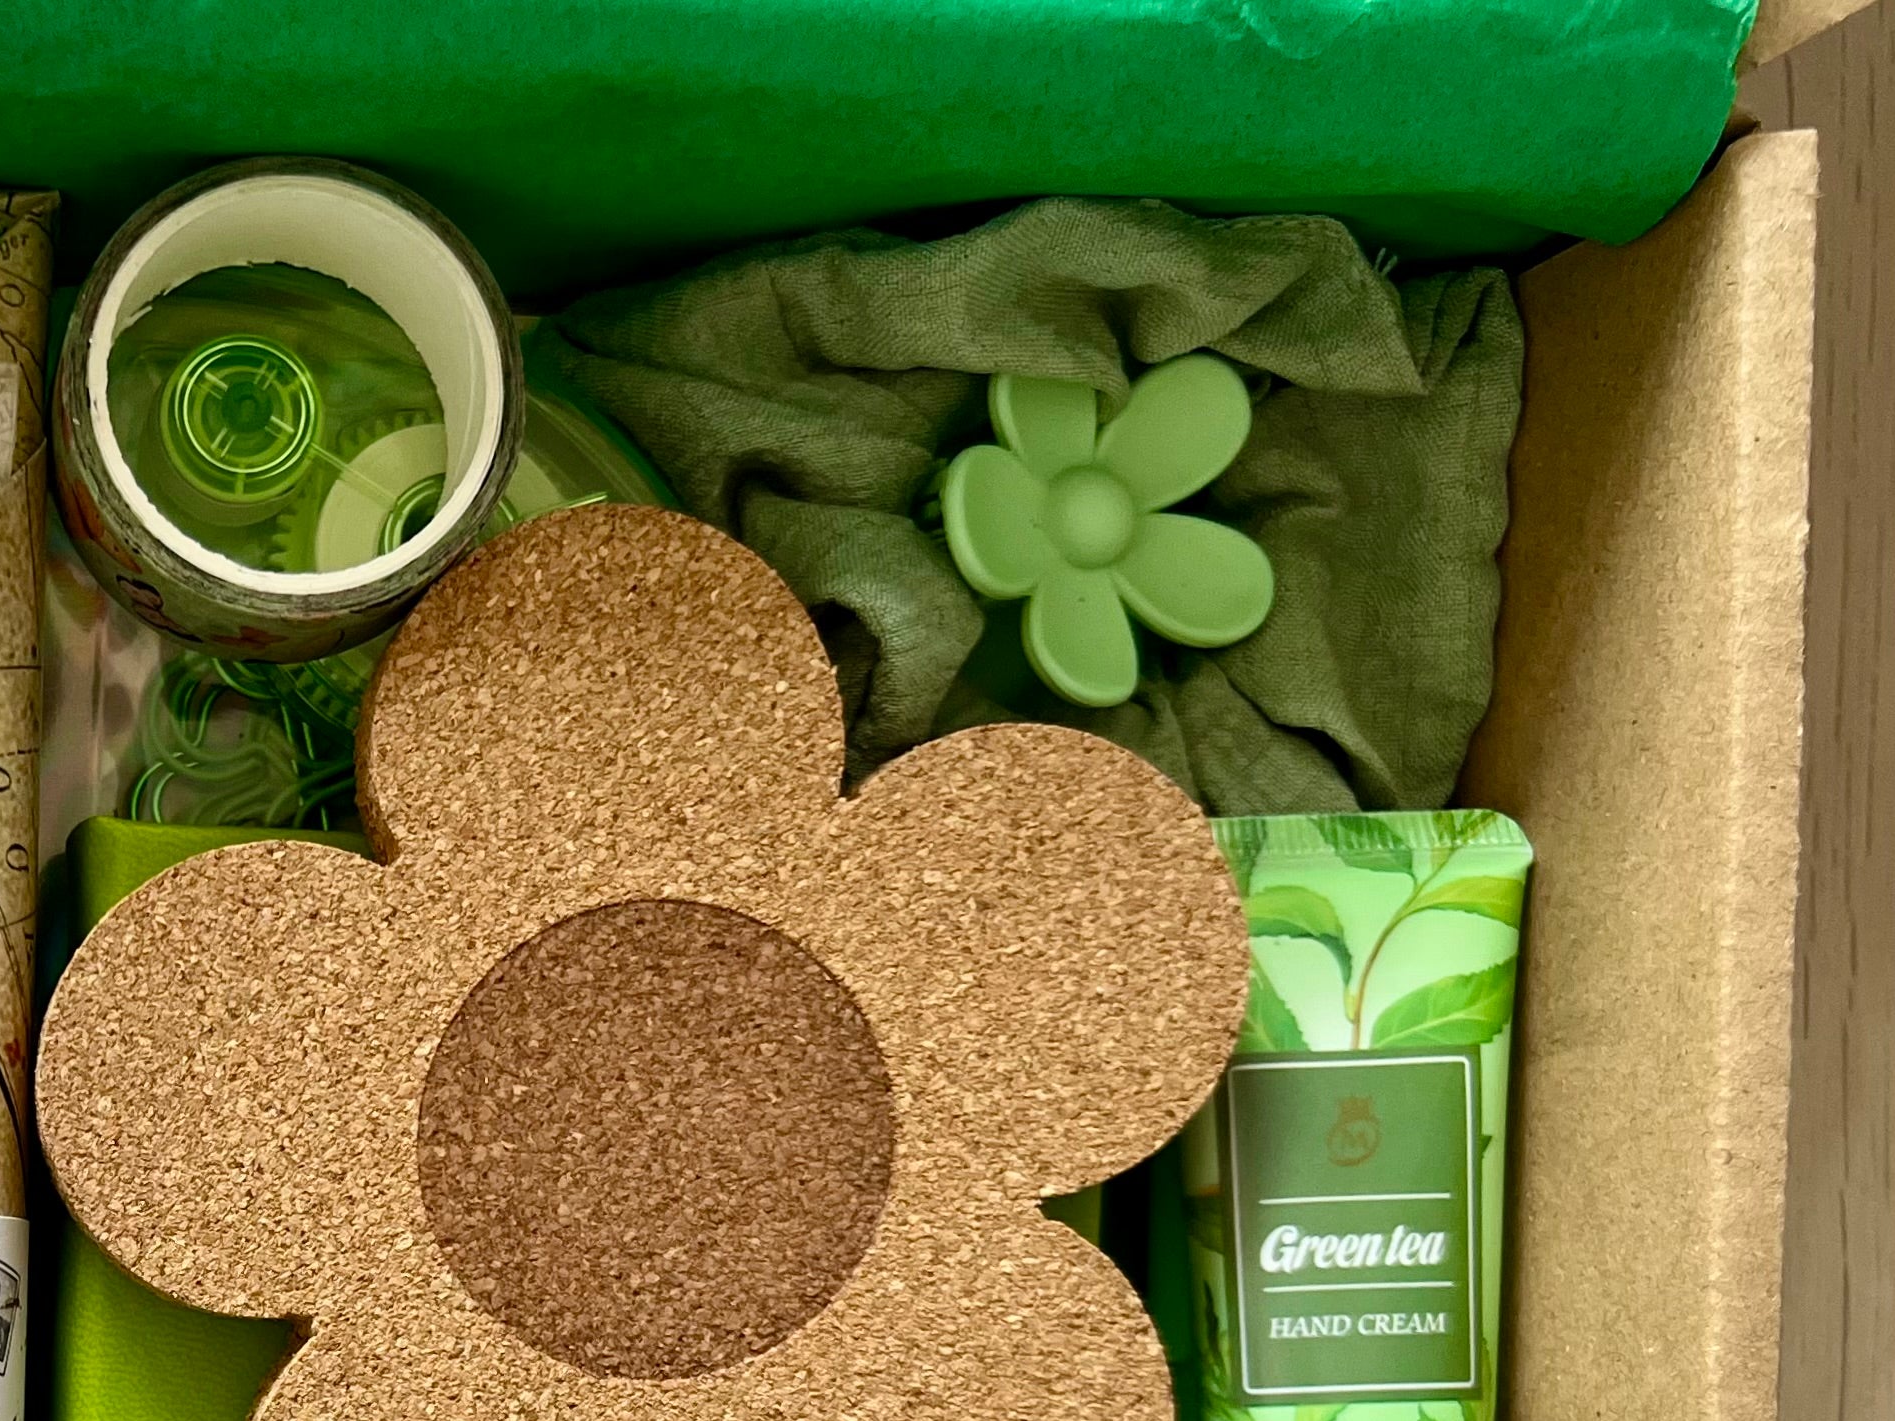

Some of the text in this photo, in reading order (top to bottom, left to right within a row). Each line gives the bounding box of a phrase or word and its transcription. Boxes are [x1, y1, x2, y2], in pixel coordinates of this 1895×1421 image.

[1259, 1223, 1446, 1274] Green tea
[1268, 1311, 1448, 1339] HAND CREAM
